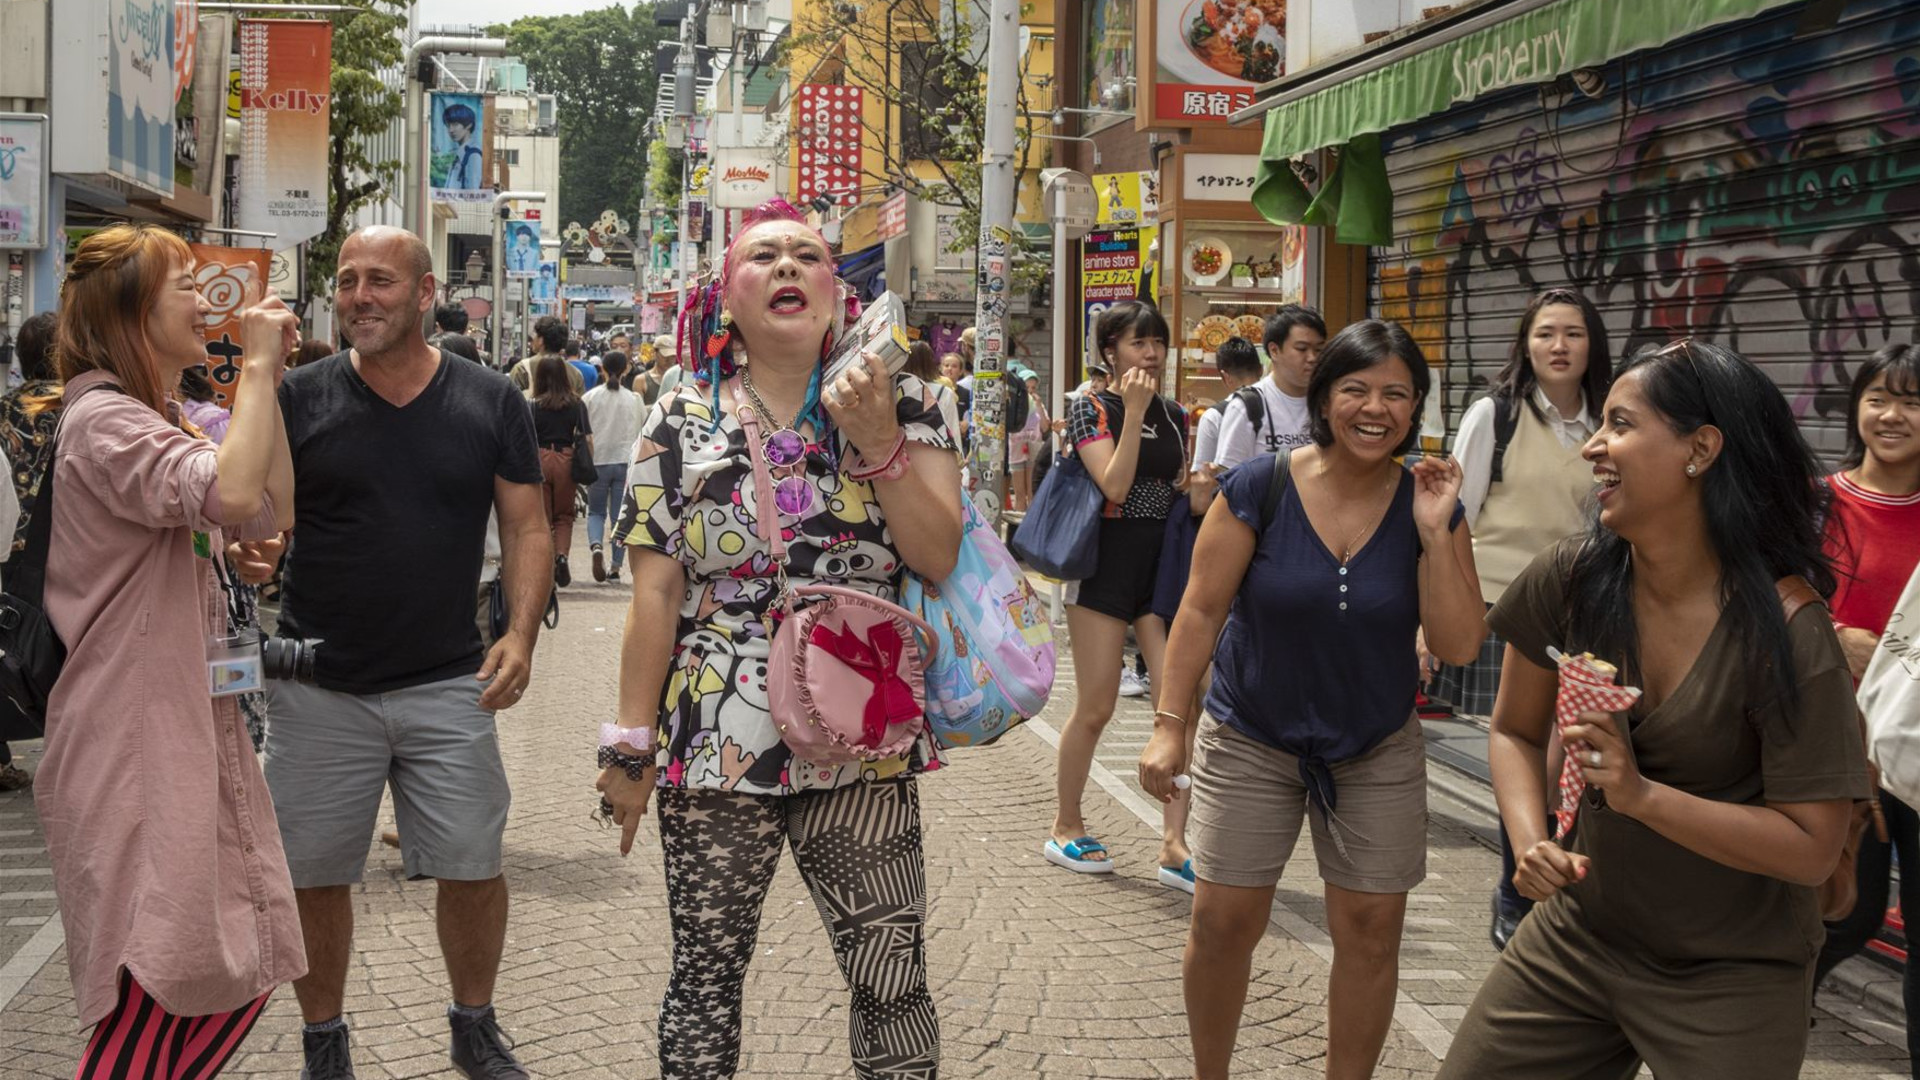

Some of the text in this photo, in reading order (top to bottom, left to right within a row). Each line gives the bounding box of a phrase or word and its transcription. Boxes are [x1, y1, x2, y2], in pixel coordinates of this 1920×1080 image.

[241, 88, 329, 115] Kelly
[1182, 91, 1251, 116] 原宿ミ
[814, 96, 830, 194] ACDC RAG
[1113, 230, 1138, 241] Hearts
[1085, 253, 1136, 269] anime store
[1085, 284, 1134, 300] character goods
[1265, 434, 1314, 446] DCSHOE
